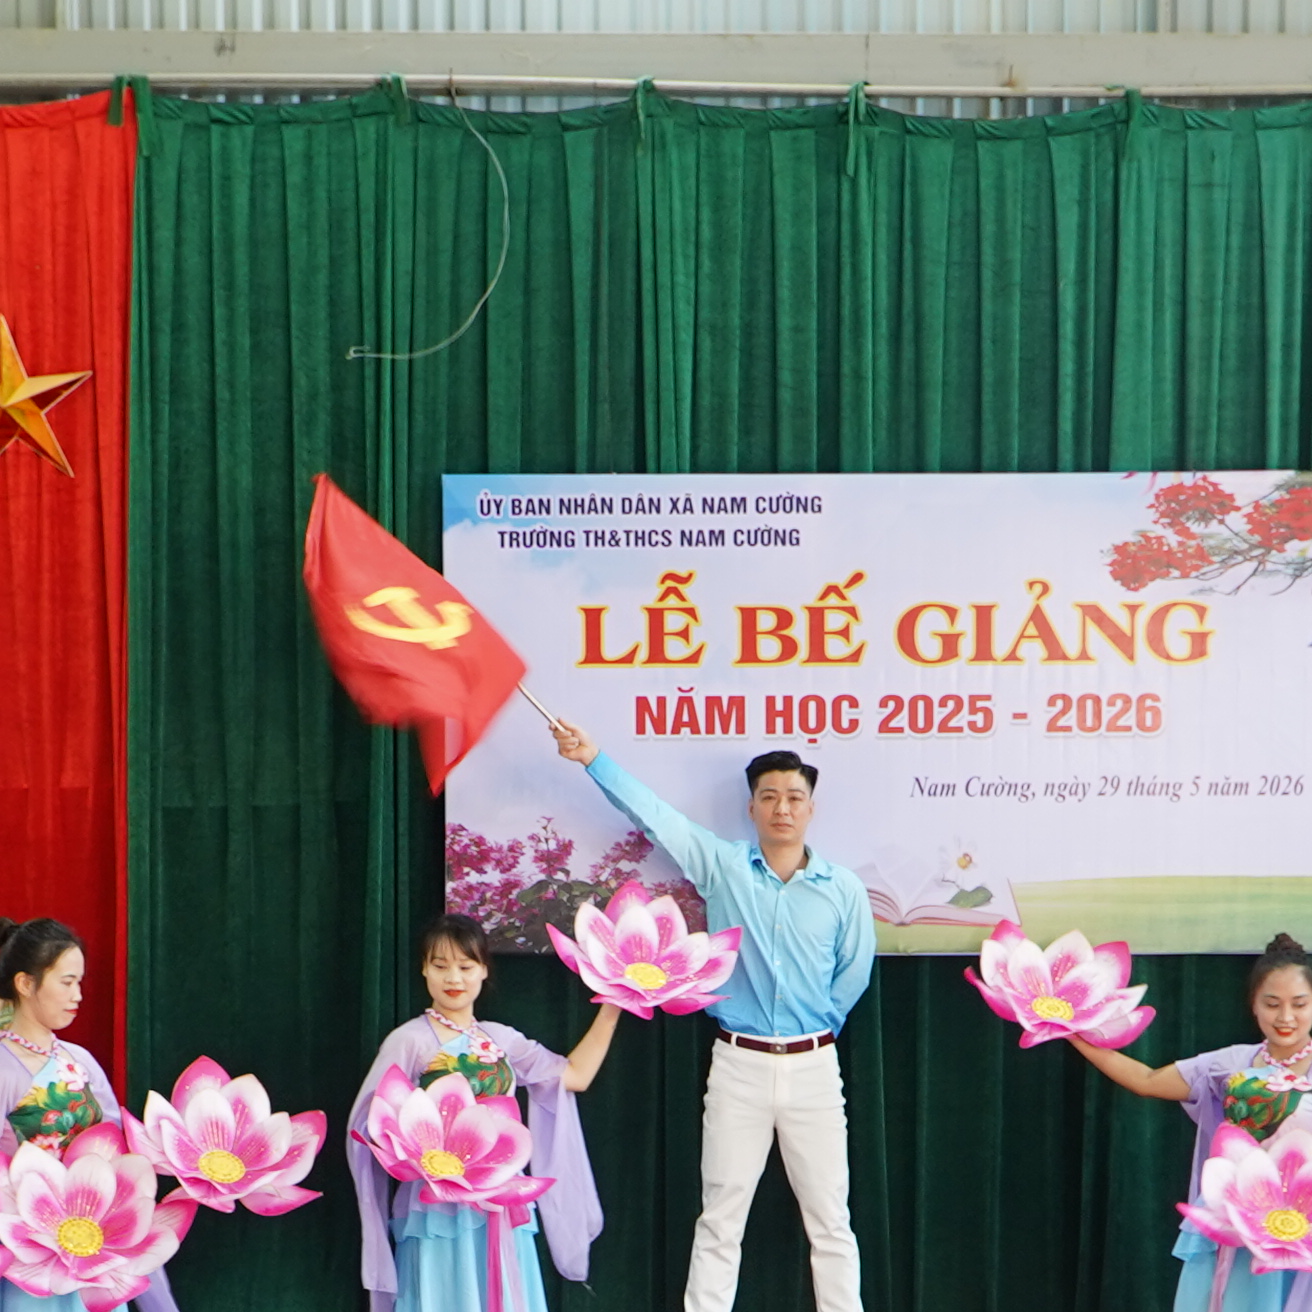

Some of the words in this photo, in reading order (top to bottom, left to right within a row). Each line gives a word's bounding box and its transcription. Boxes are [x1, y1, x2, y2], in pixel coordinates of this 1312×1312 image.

[479, 492, 504, 516] ỦY
[511, 498, 551, 516] BAN
[558, 493, 613, 515] NHÂN
[621, 493, 661, 515] DÂN
[669, 493, 694, 515] XÃ
[702, 497, 747, 515] NAM
[755, 491, 822, 514] CƯỜNG
[498, 525, 576, 549] TRƯỜNG
[583, 529, 672, 548] TH&THCS
[680, 529, 725, 547] NAM
[733, 524, 800, 547] CƯỜNG
[575, 569, 707, 668] LỄ
[731, 569, 868, 667] BẾ
[893, 578, 1215, 667] GIẢNG
[634, 686, 746, 736] NĂM
[764, 694, 860, 744] HỌC
[878, 694, 995, 735] 2025
[1046, 692, 1163, 734] 2026
[910, 776, 956, 798] Nam
[965, 775, 1036, 803] Cường,
[1043, 775, 1091, 803] ngày
[1097, 775, 1120, 797] 29
[1126, 775, 1184, 803] tháng
[1189, 776, 1202, 797] 5
[1207, 776, 1250, 797] năm
[1257, 774, 1304, 797] 2026
